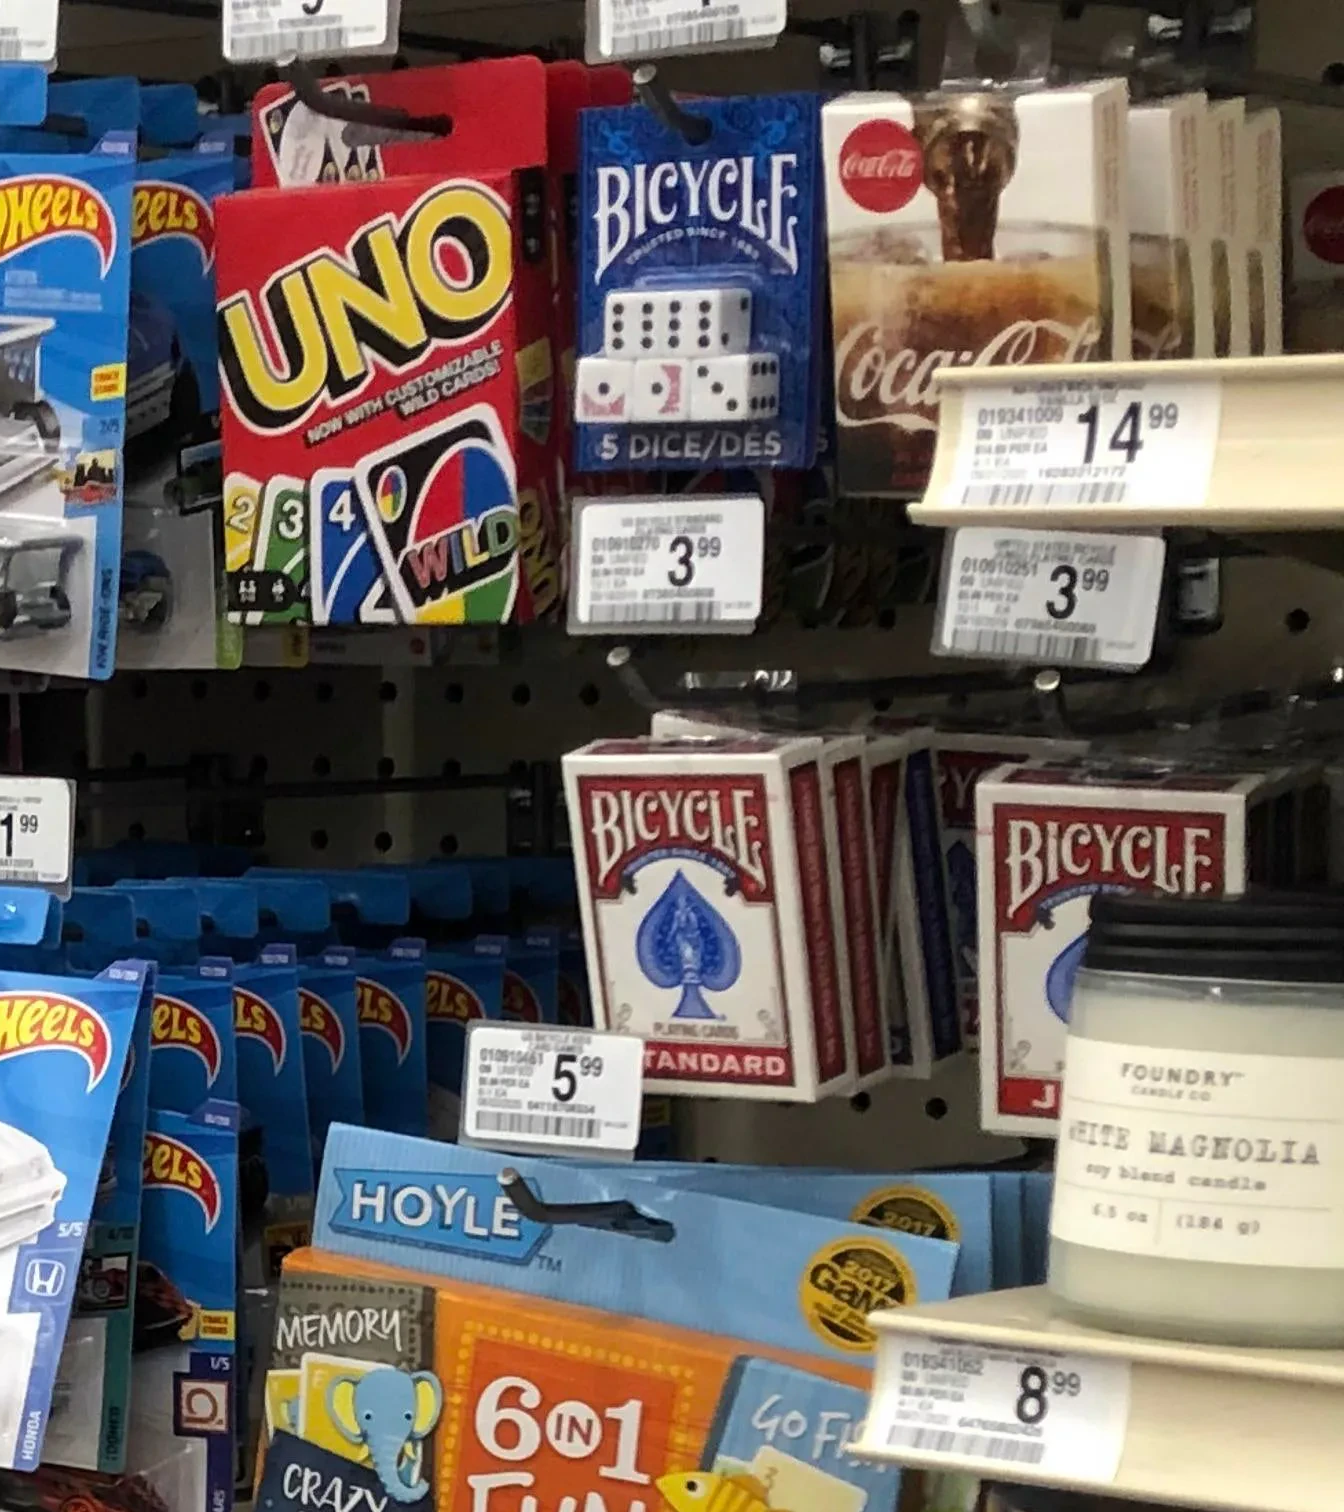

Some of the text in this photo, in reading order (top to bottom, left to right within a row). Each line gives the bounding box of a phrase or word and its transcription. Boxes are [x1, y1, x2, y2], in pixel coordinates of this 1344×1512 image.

[593, 154, 798, 286] BICYCLE
[220, 190, 513, 416] UNO
[306, 340, 504, 445] NOW WITH CUSTOMIZABLE
[400, 359, 502, 416] WILD CARDS!
[600, 433, 618, 460] 5
[228, 490, 516, 590] 2 3 4 WILD
[590, 788, 766, 897] BICYCLE
[1006, 817, 1212, 922] BICYCLE
[644, 1049, 786, 1076] TANDARD
[1120, 1064, 1233, 1088] FOUNDRY
[1149, 1130, 1318, 1166] MAGNOLIA
[1119, 1165, 1266, 1193] blend candle
[351, 1180, 521, 1240] HOYLE
[840, 1259, 897, 1293] 2017
[277, 1309, 403, 1352] MEMORY
[476, 1376, 651, 1485] 6 IN 1
[752, 1394, 808, 1441] GO
